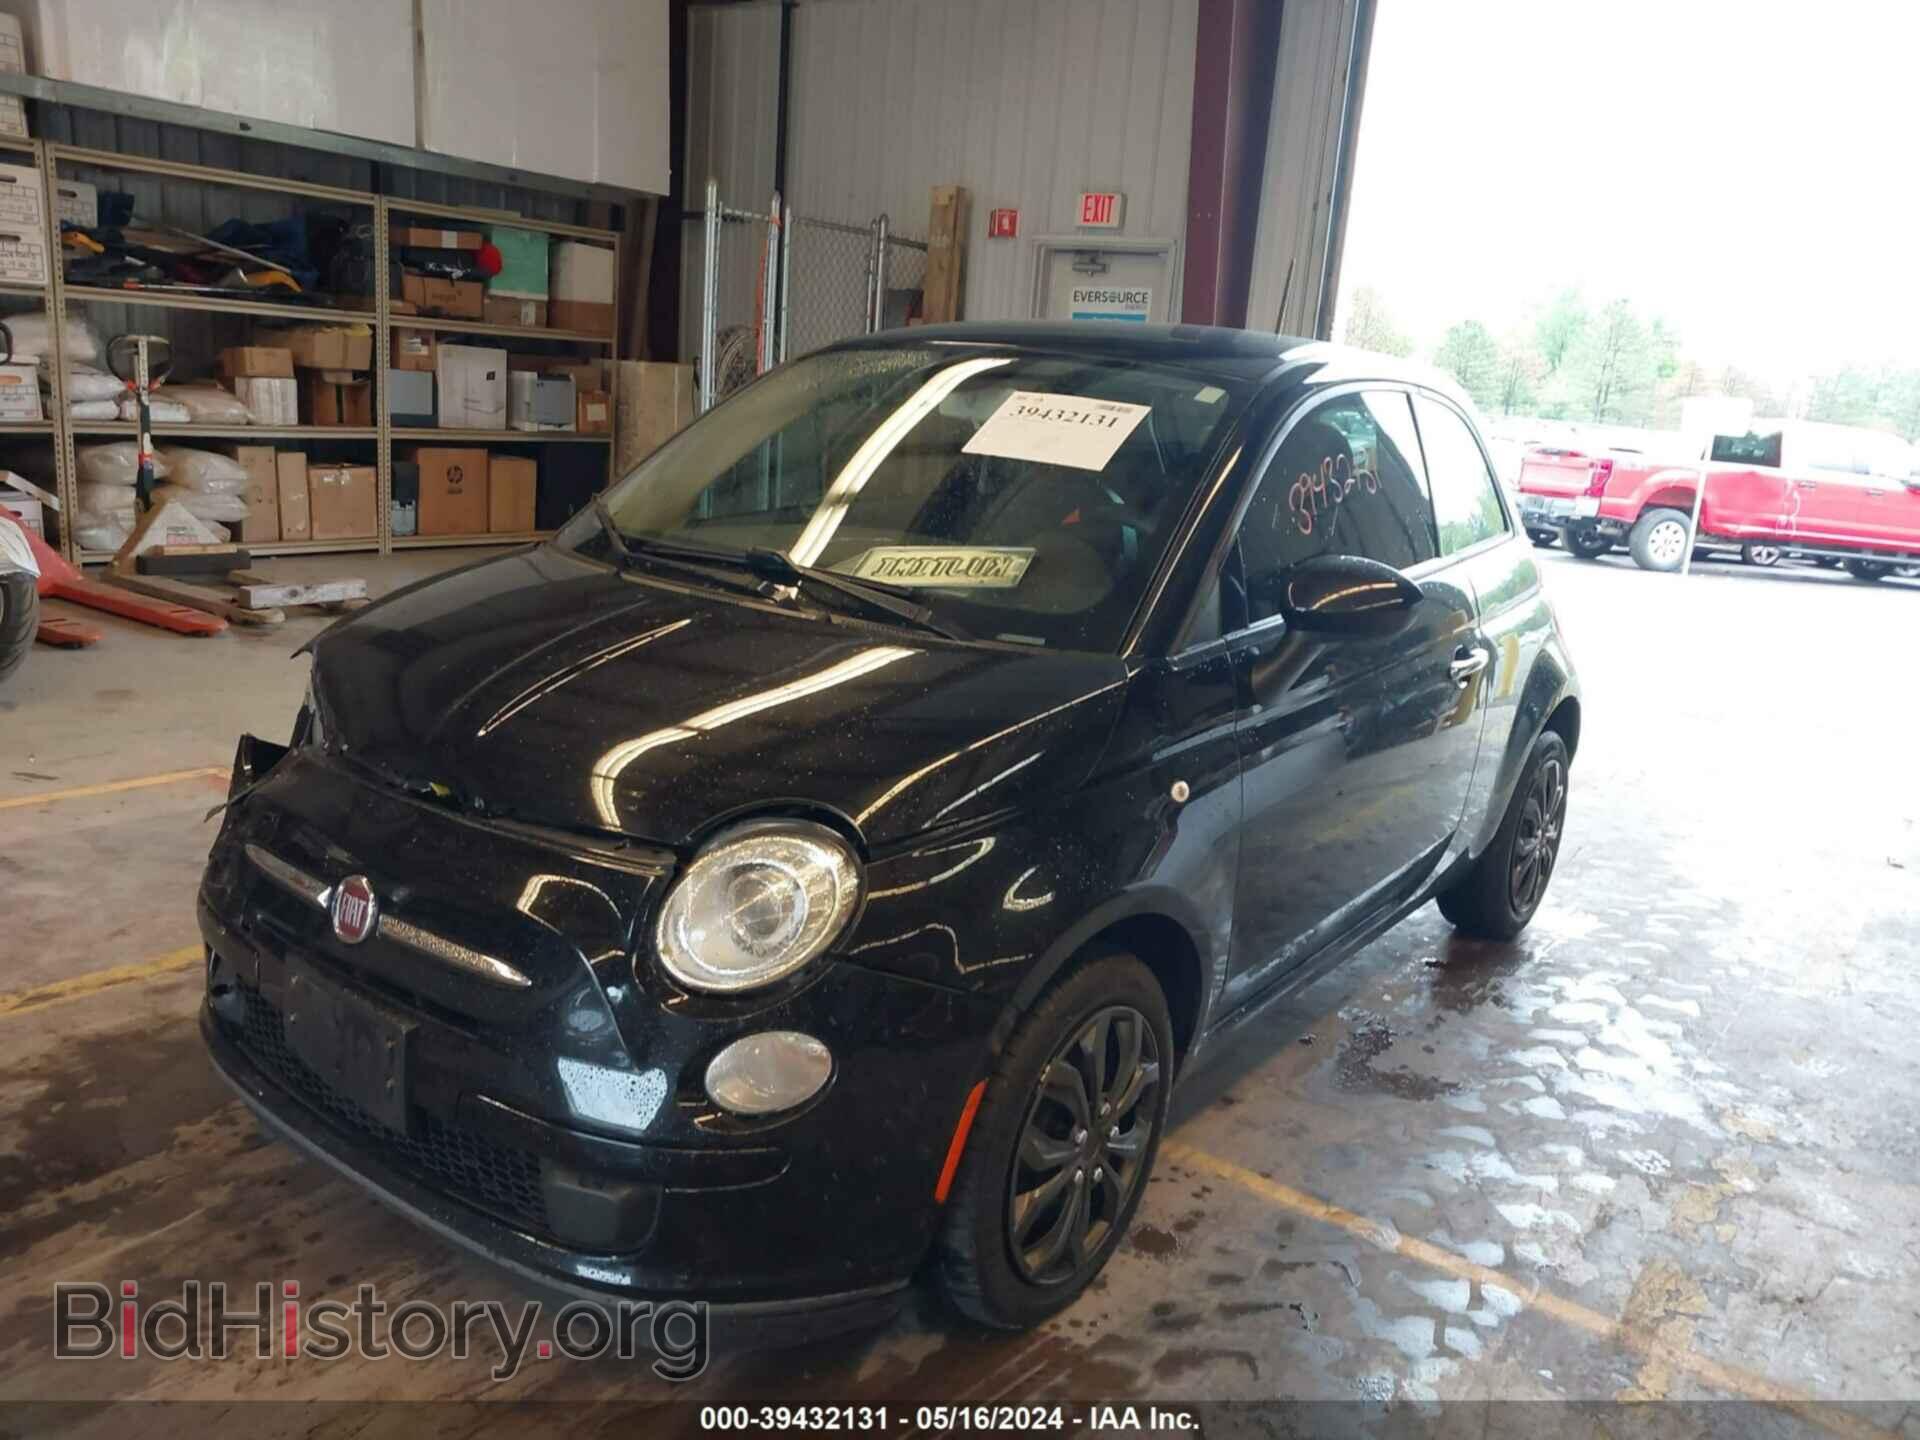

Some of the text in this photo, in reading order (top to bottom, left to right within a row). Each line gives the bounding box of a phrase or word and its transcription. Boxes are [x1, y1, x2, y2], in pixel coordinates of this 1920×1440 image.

[1082, 194, 1115, 223] EXIT
[1073, 290, 1149, 304] EVERSOURCE
[1009, 404, 1119, 429] 39432131
[340, 892, 367, 929] FIAT
